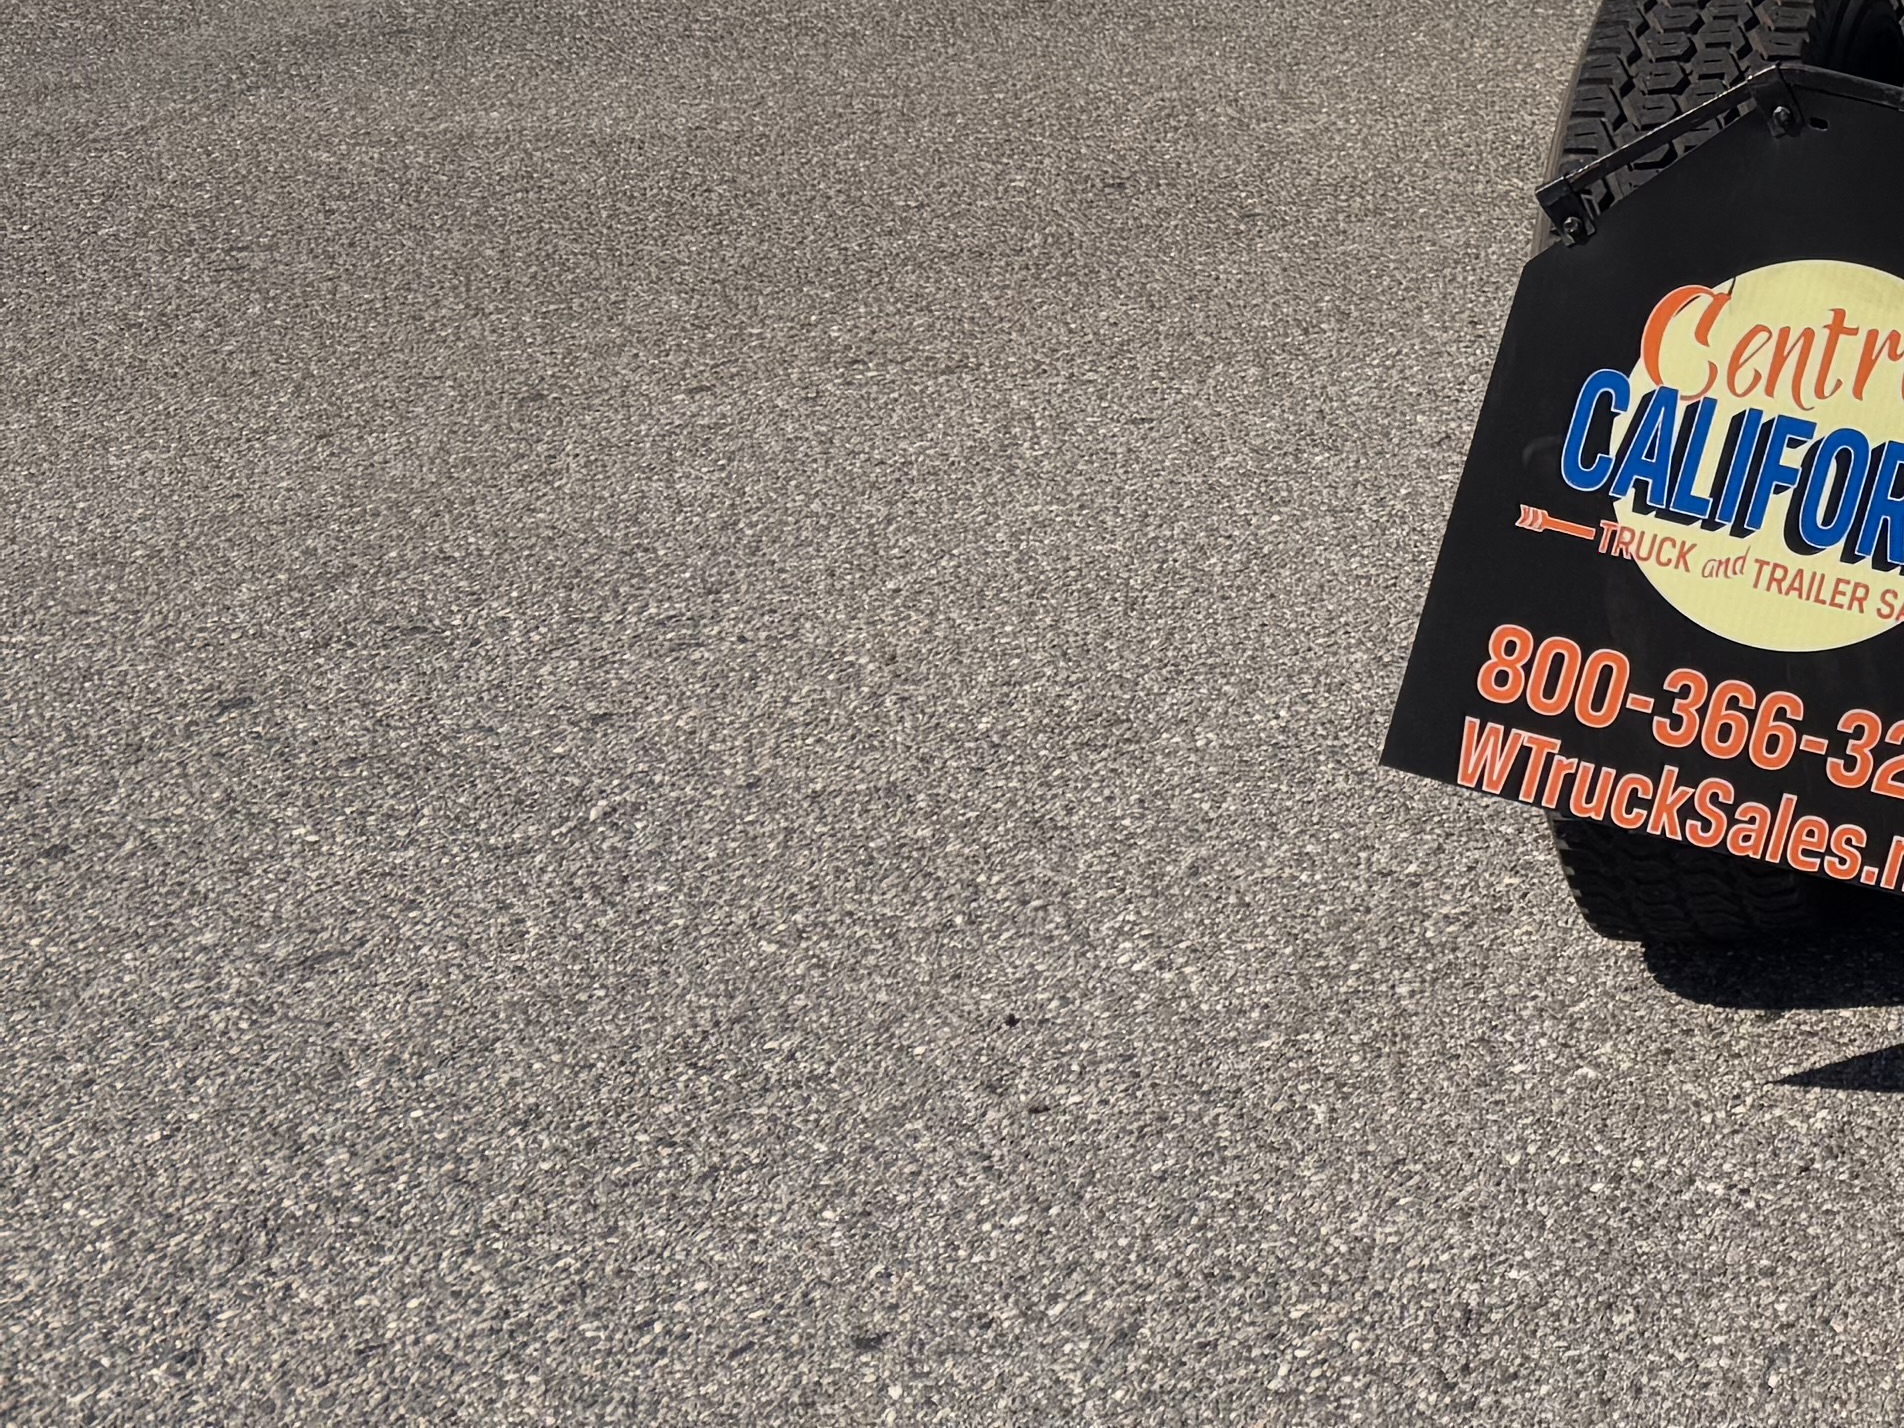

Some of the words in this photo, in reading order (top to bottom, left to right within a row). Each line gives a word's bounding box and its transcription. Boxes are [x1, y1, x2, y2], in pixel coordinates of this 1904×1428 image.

[1598, 520, 1697, 574] TRUCK
[1702, 546, 1750, 581] and
[1751, 558, 1870, 615] TRAILER
